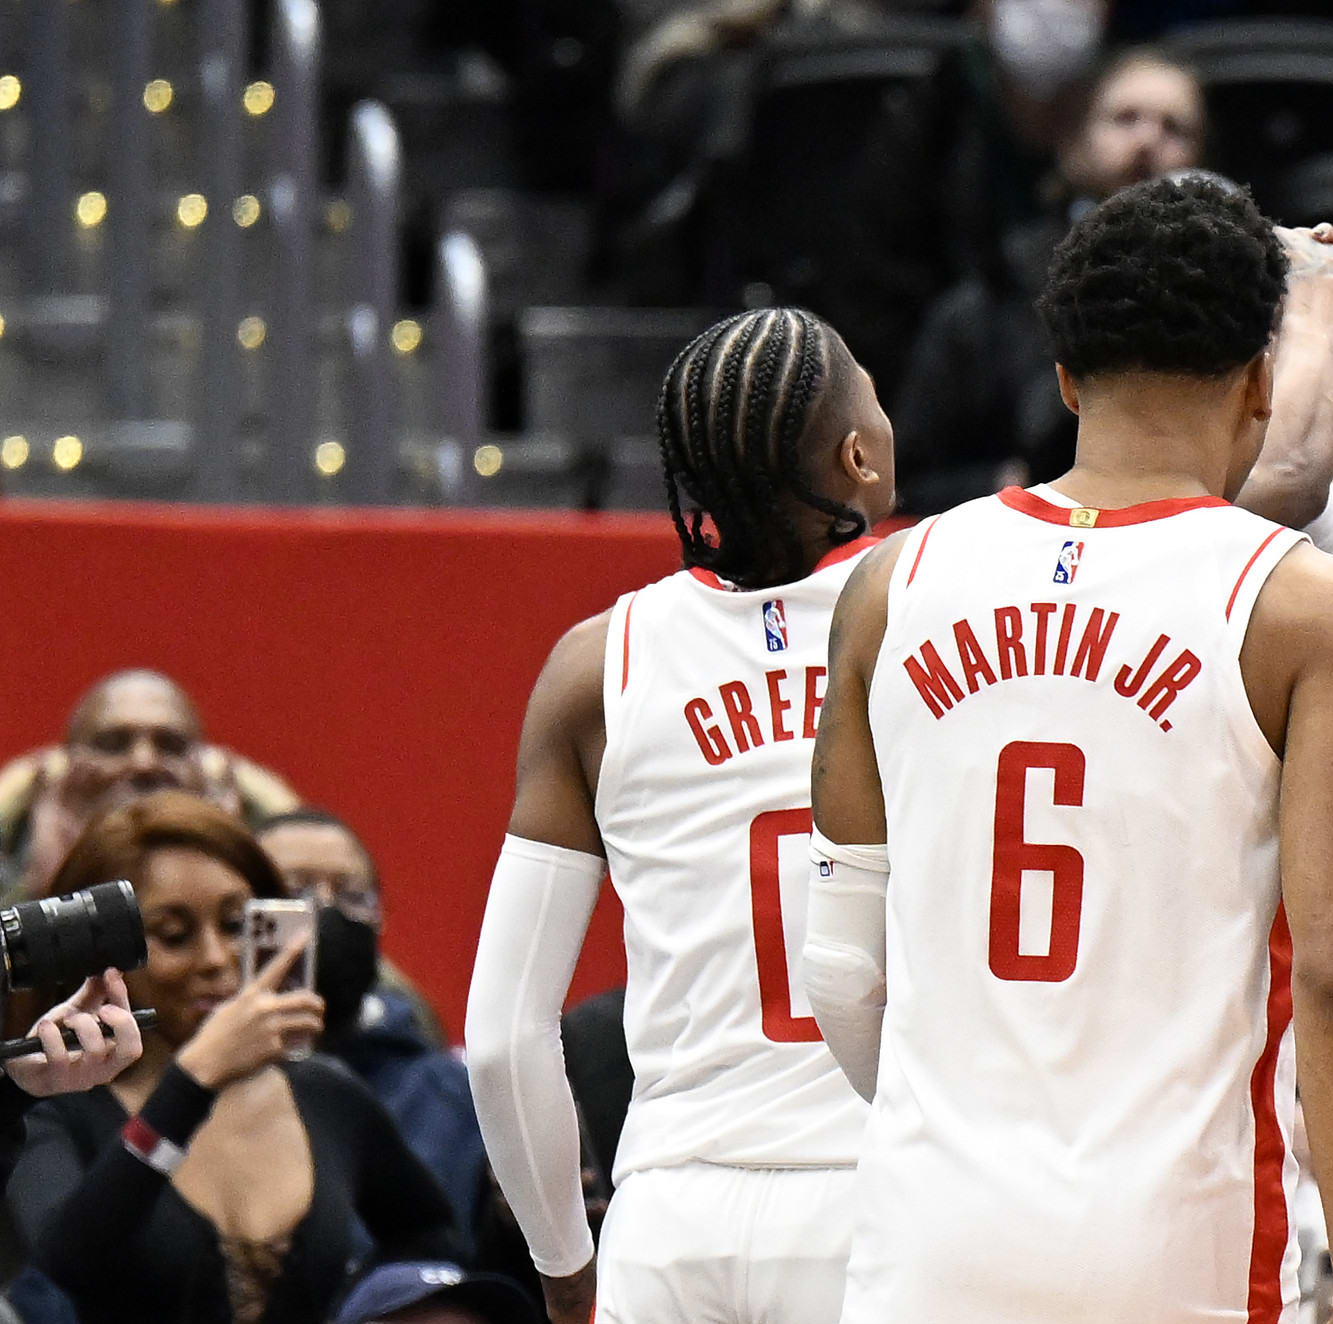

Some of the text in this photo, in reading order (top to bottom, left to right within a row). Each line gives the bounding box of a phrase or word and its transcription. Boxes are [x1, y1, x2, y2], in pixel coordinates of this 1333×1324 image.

[903, 602, 1201, 732] MARTIN JR.
[989, 741, 1086, 983] 6
